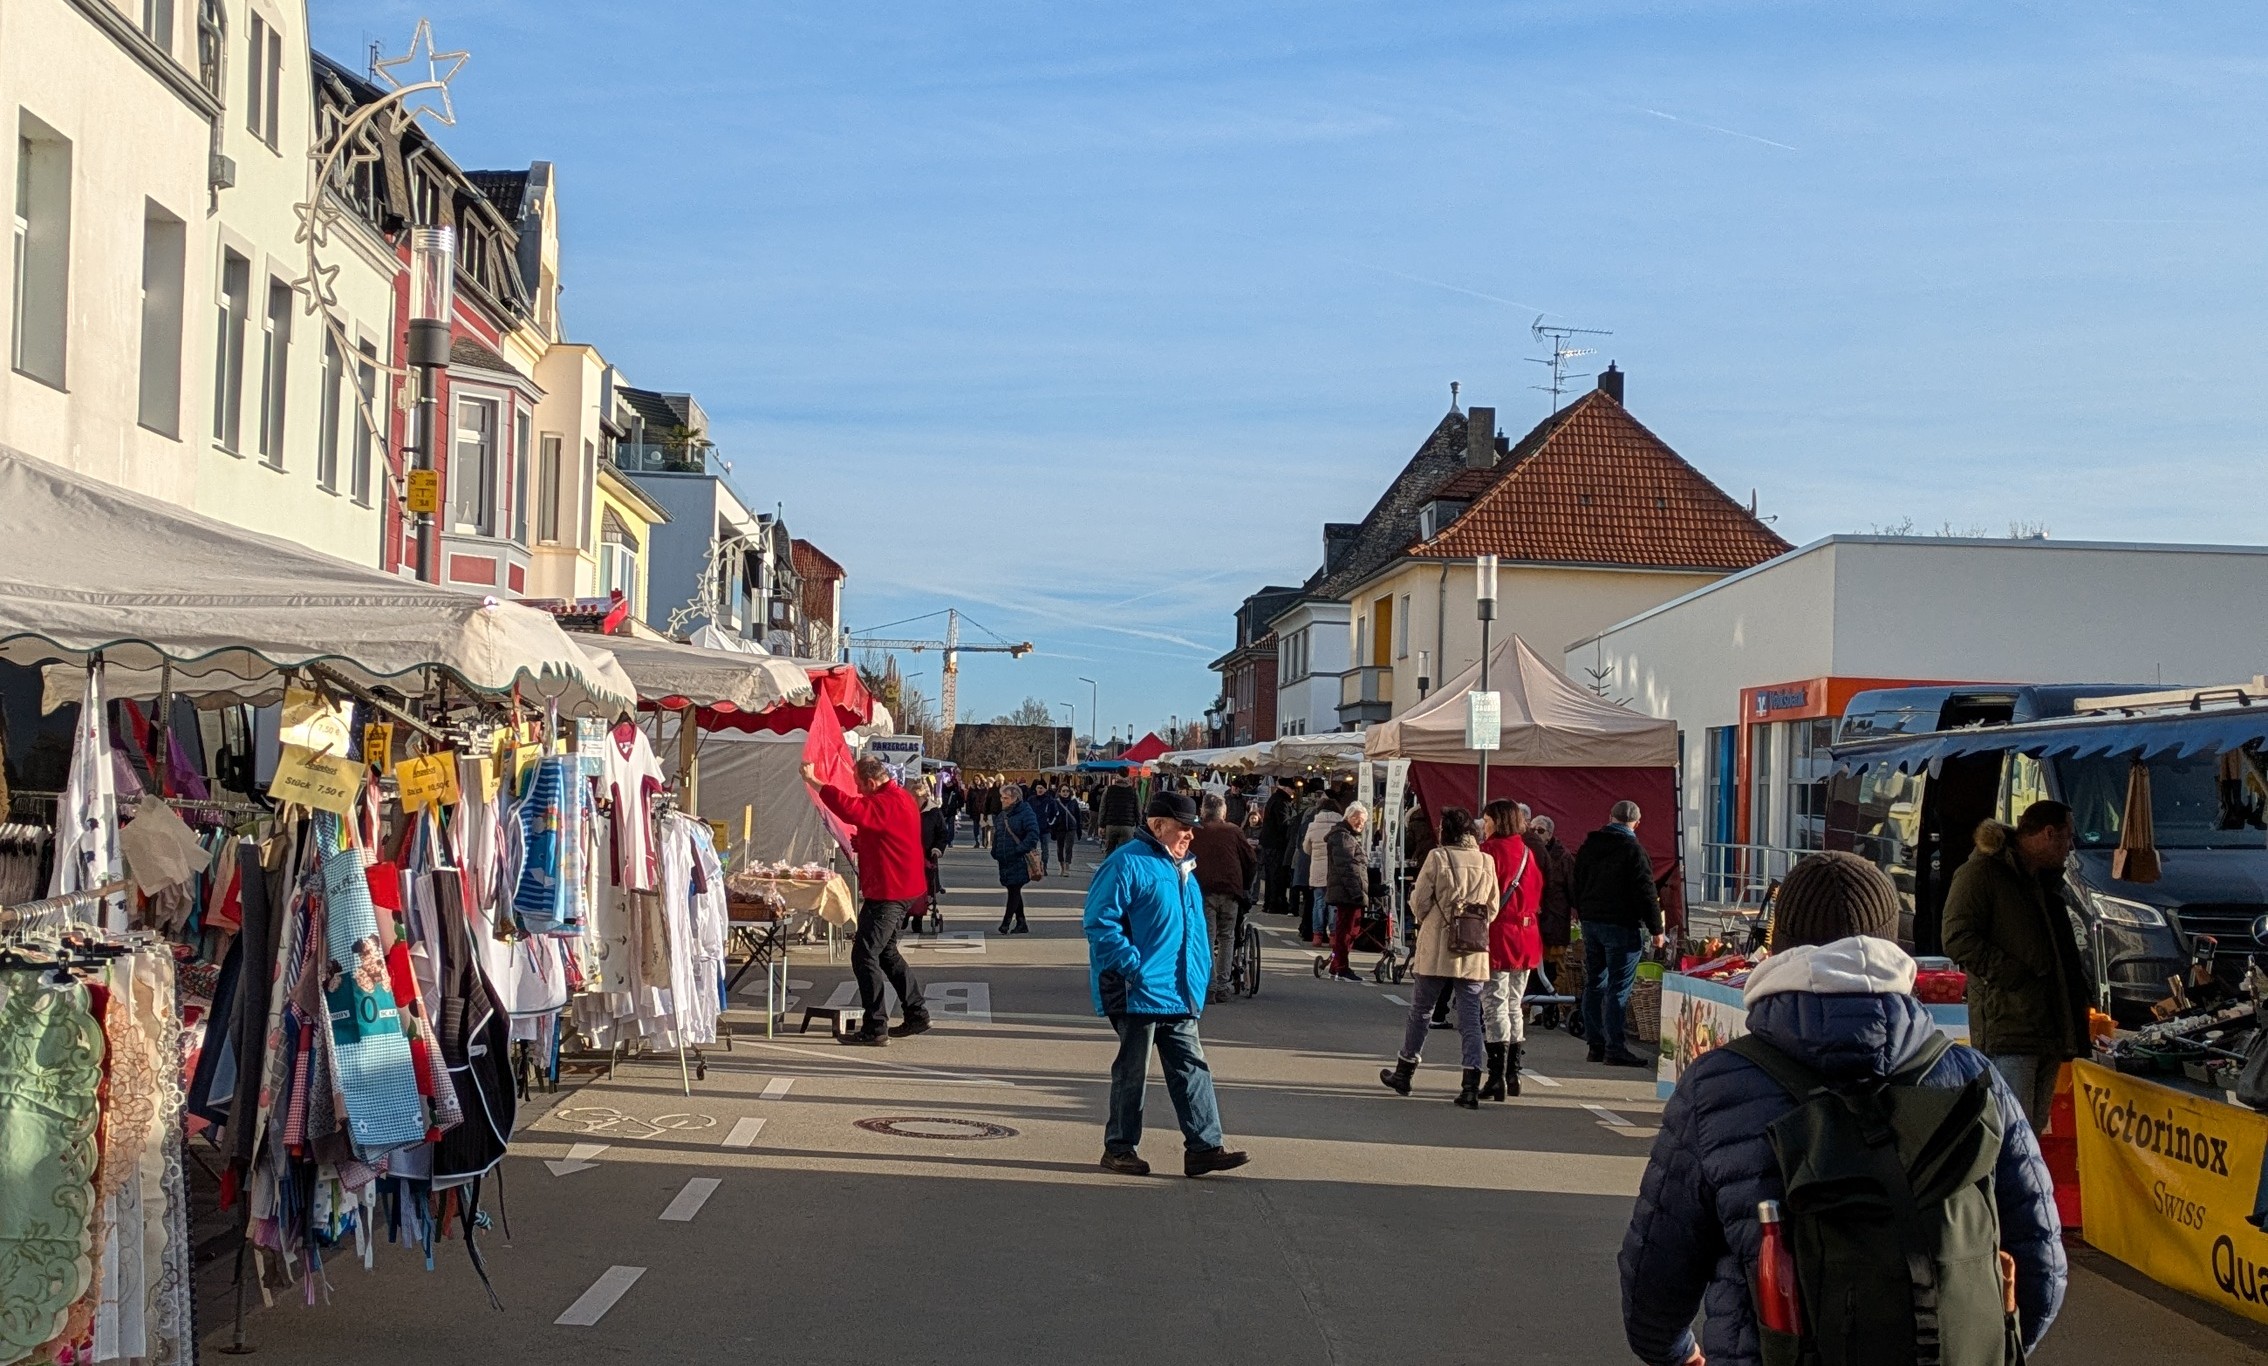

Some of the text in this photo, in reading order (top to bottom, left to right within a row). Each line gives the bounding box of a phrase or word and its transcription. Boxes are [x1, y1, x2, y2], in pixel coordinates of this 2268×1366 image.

[872, 742, 919, 751] PANZERGLAS
[285, 776, 345, 798] Stück 7,50 €
[2083, 1083, 2229, 1177] Victorinox
